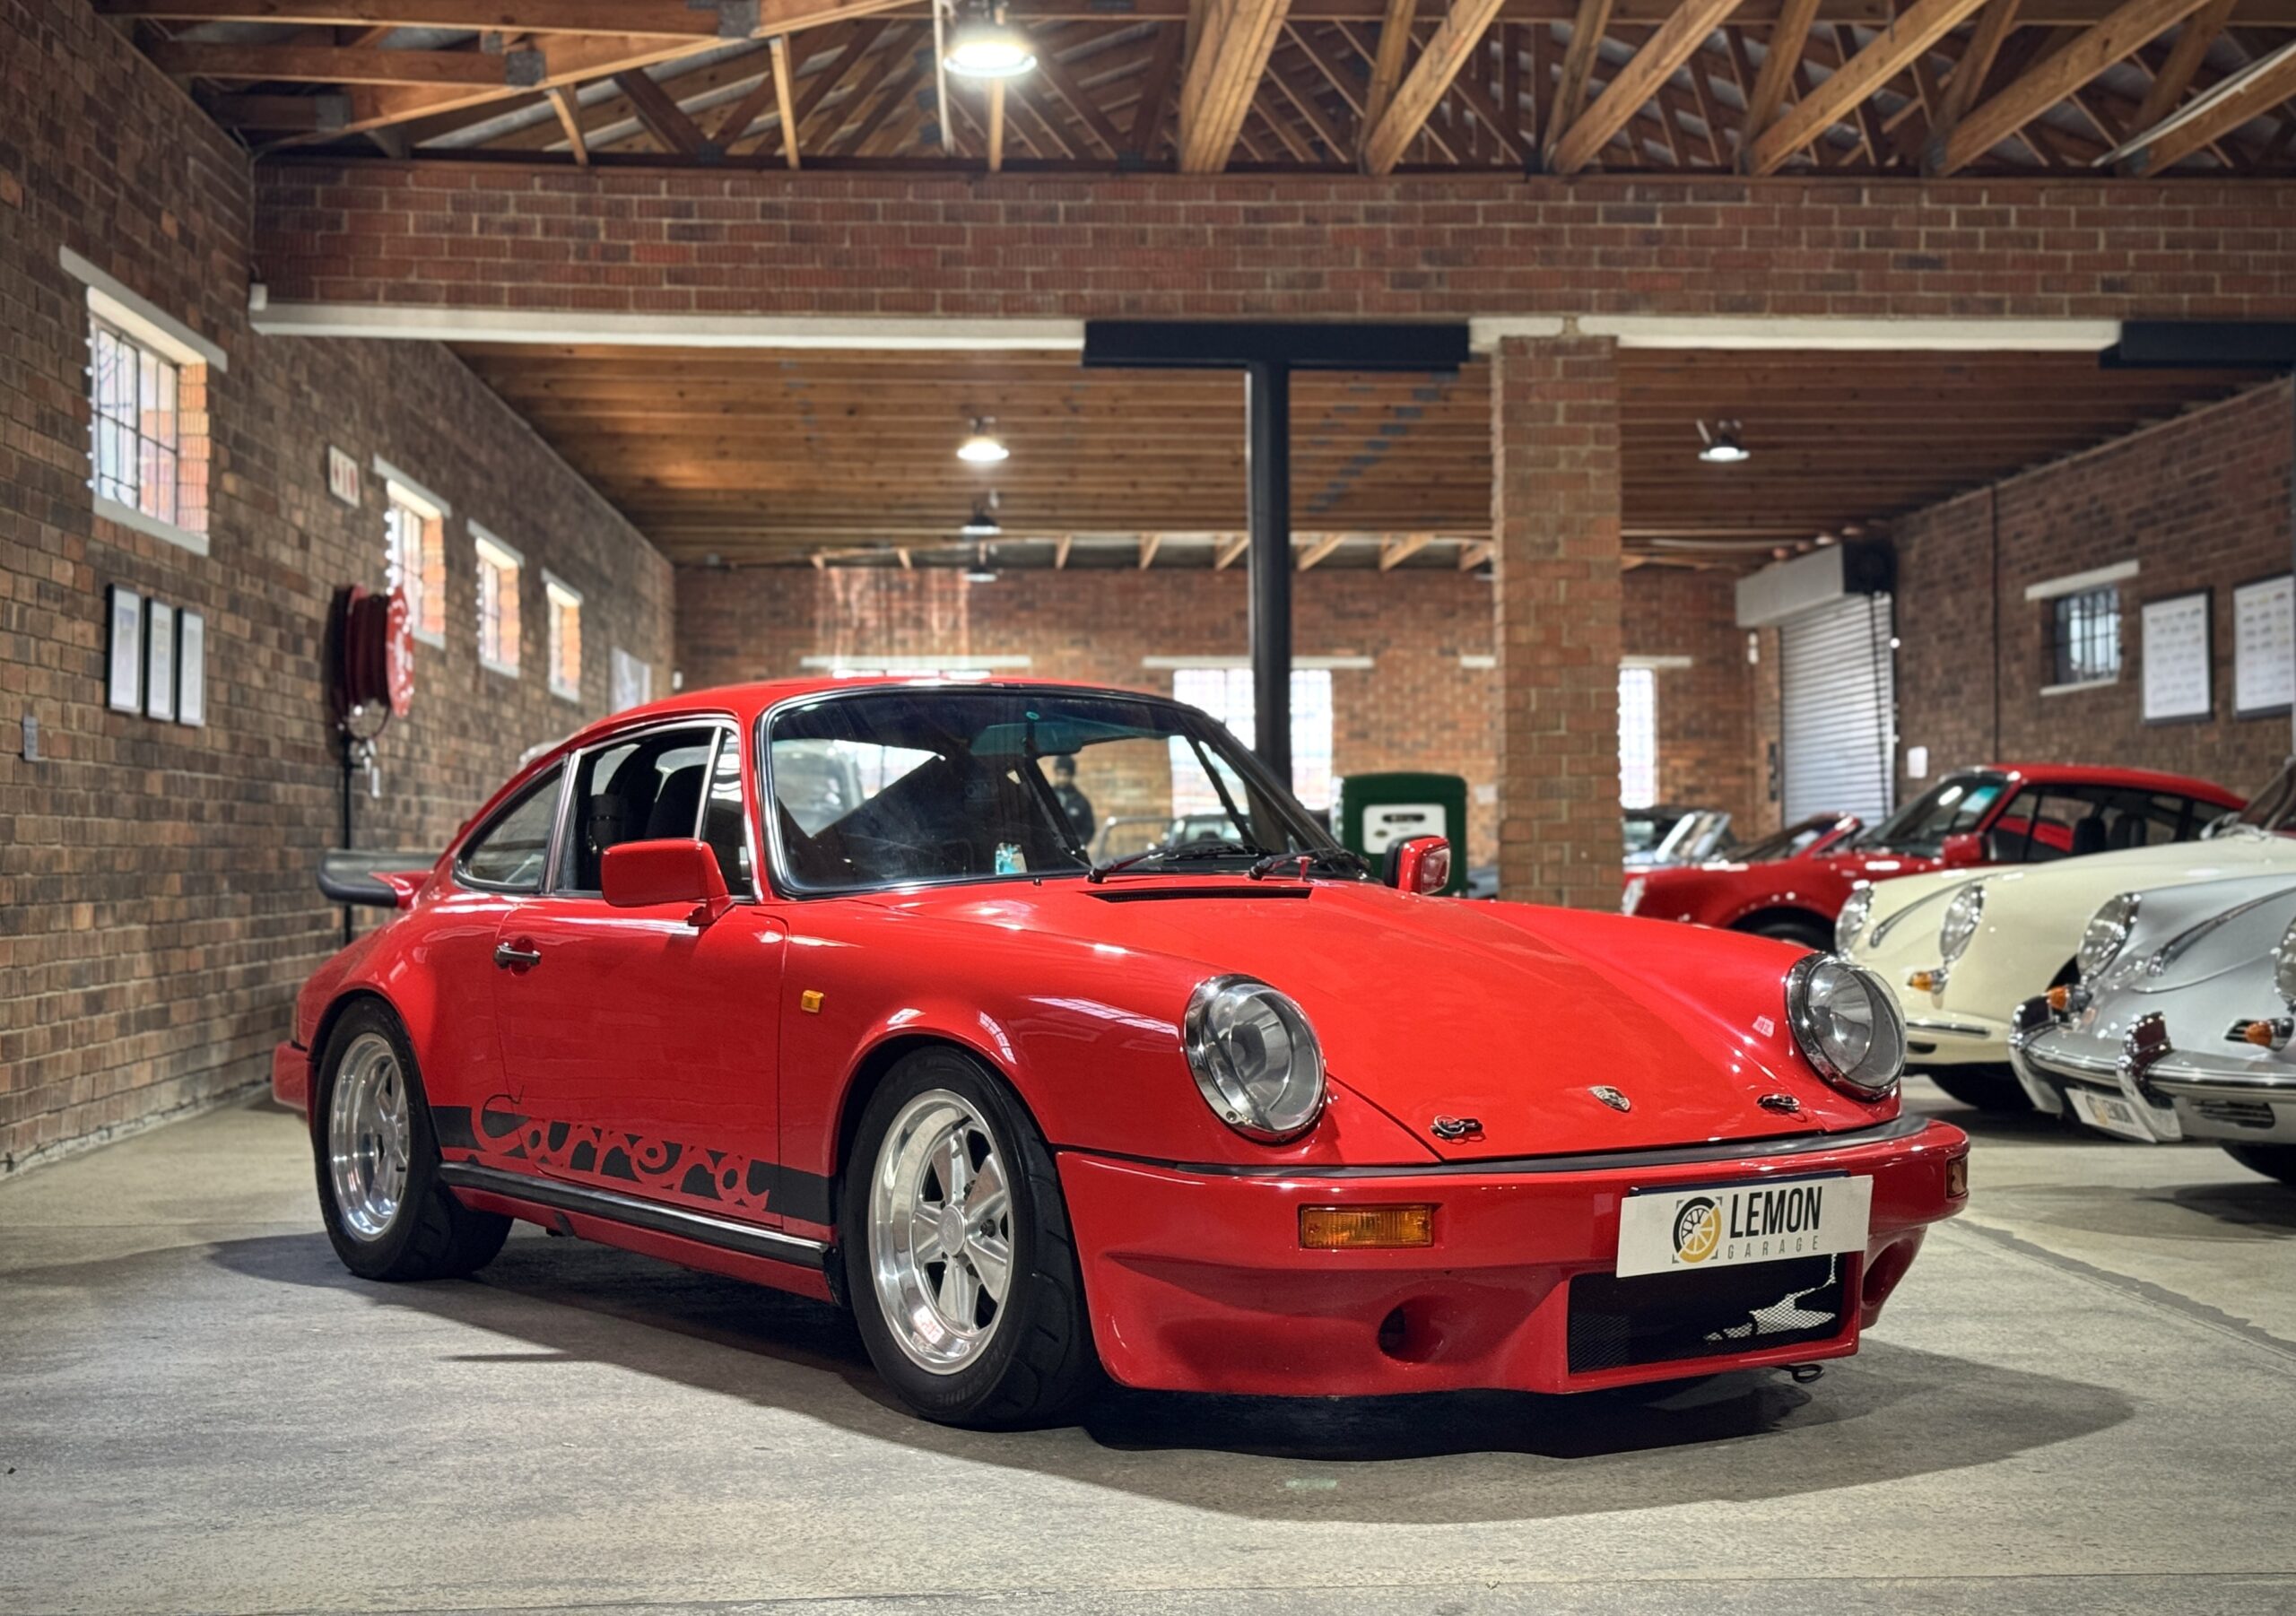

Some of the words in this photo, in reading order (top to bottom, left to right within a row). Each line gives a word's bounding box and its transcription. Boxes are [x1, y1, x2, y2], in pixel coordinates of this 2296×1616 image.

[472, 1084, 770, 1211] Carrera
[1730, 1186, 1822, 1238] LEMON
[1727, 1236, 1818, 1260] GARAGE
